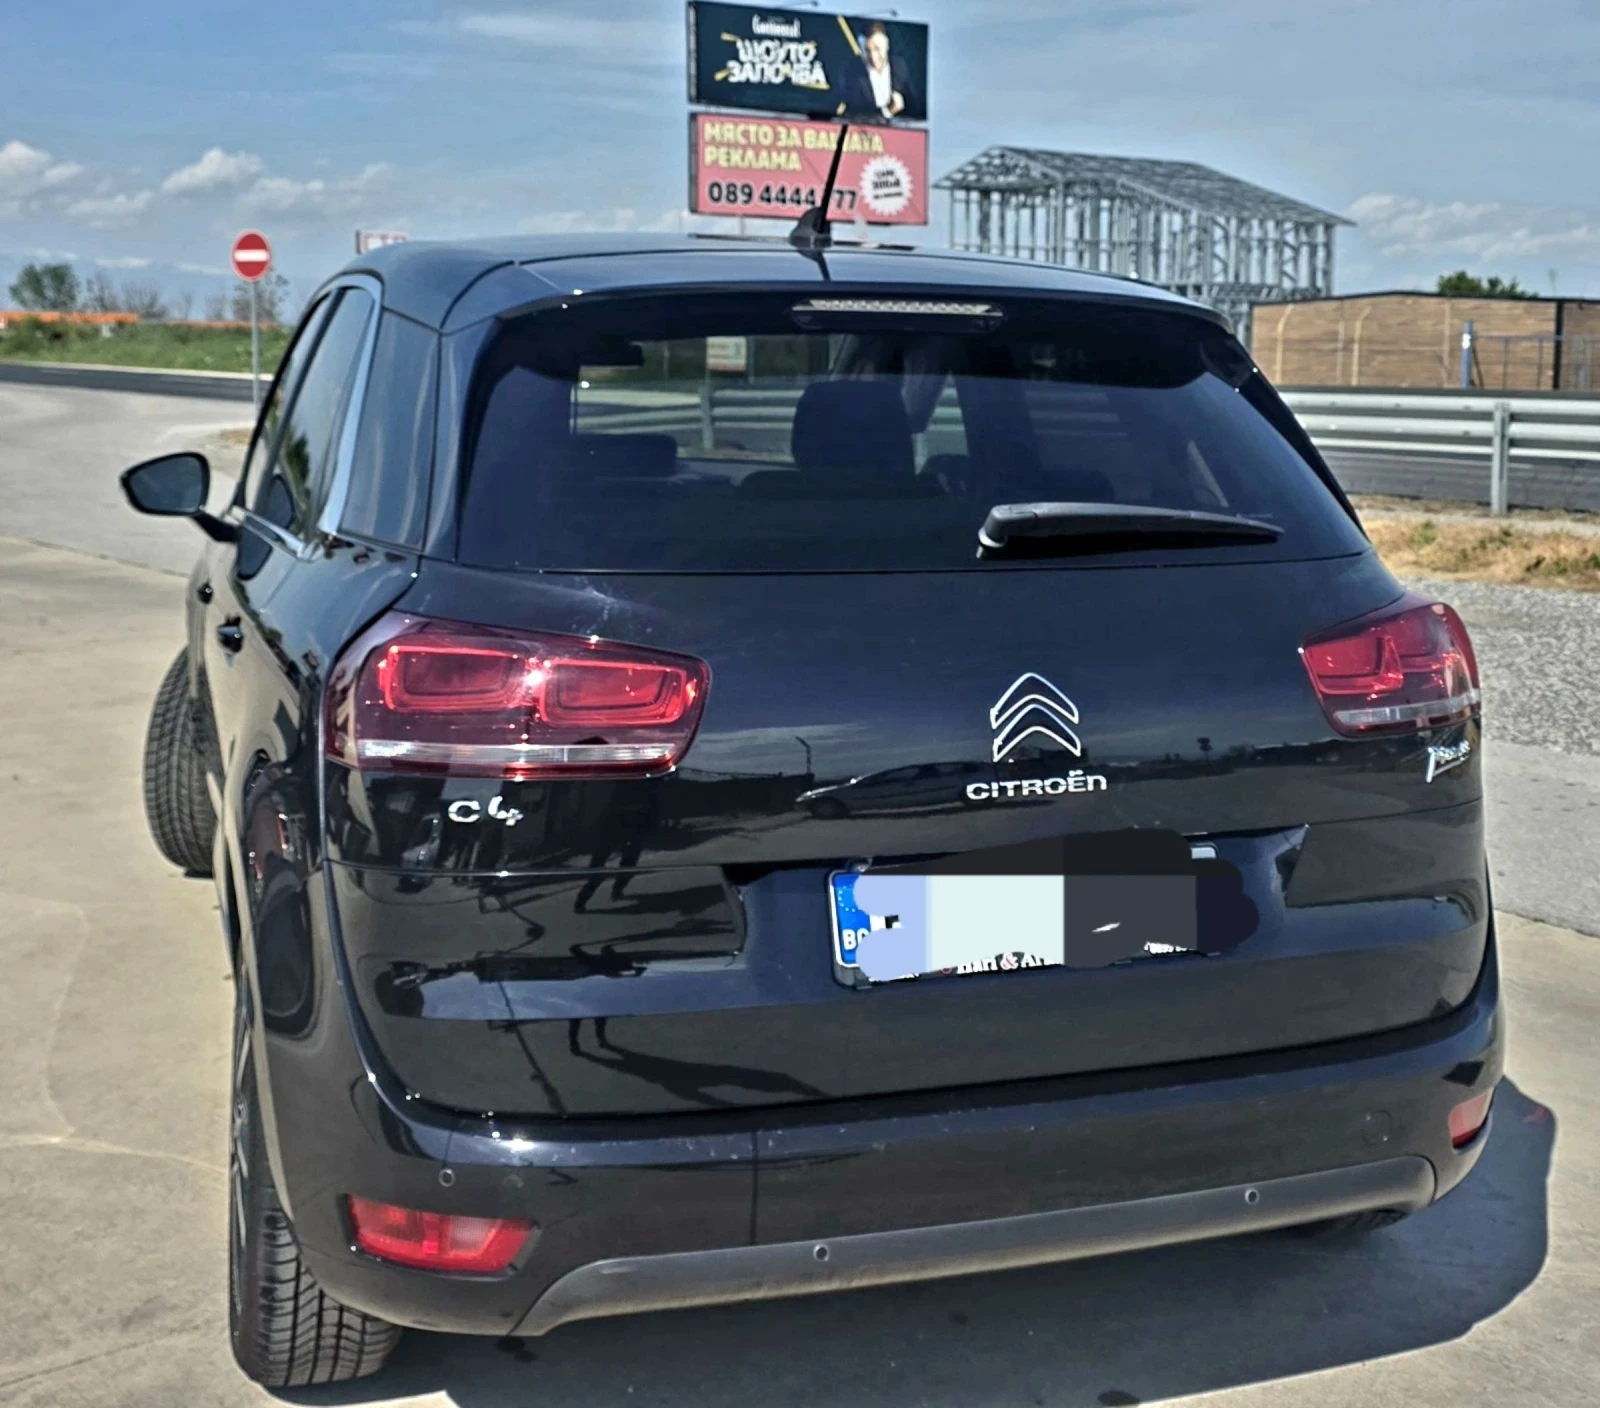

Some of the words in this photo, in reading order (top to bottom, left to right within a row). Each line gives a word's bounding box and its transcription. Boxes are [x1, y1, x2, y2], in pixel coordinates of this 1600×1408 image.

[704, 122, 774, 147] МЯСТО
[775, 128, 801, 148] ЗА
[704, 146, 802, 171] РЕКЛАМА
[708, 181, 754, 205] 089
[966, 769, 1107, 800] CITROËN
